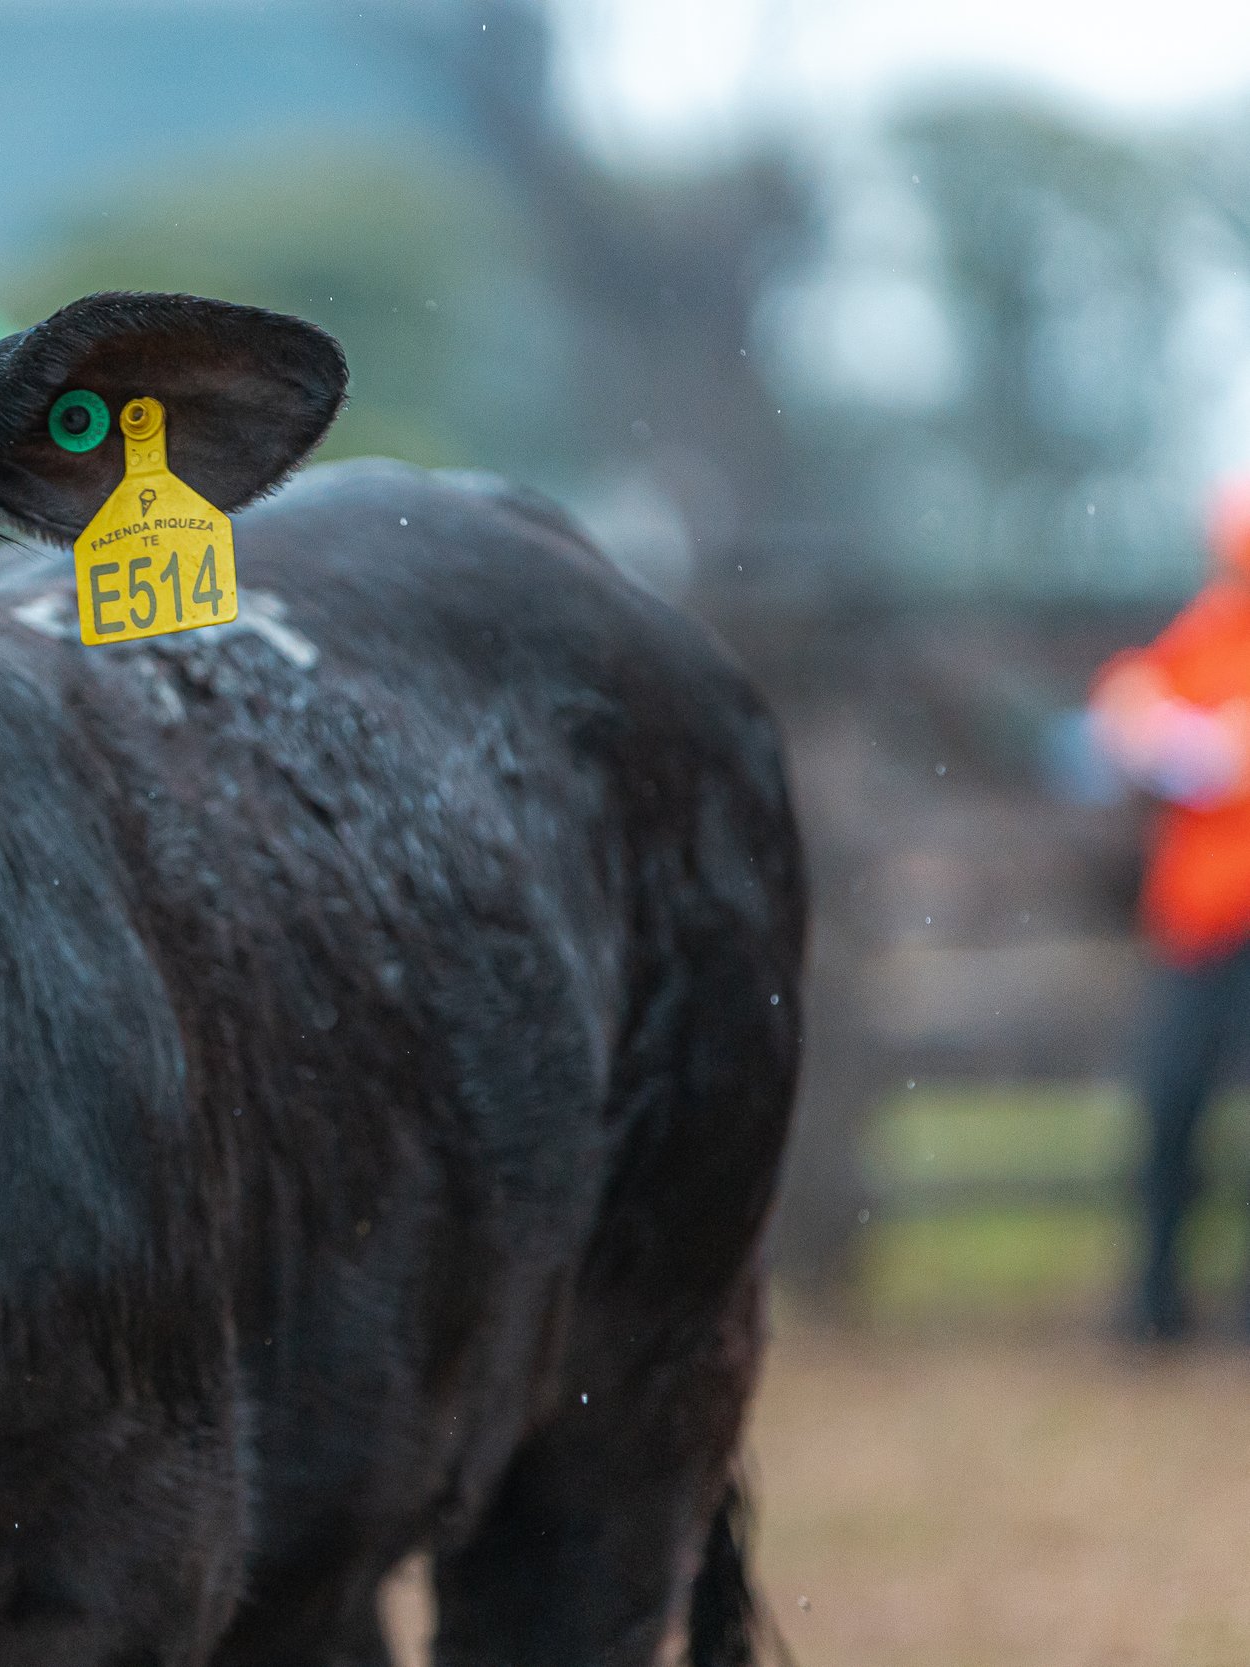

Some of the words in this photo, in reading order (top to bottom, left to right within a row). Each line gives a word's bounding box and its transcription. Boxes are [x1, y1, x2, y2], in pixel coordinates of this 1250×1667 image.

[90, 524, 152, 551] FAZENDA
[154, 518, 214, 532] RIQUEZA
[141, 534, 160, 547] TE
[89, 544, 223, 635] E514
